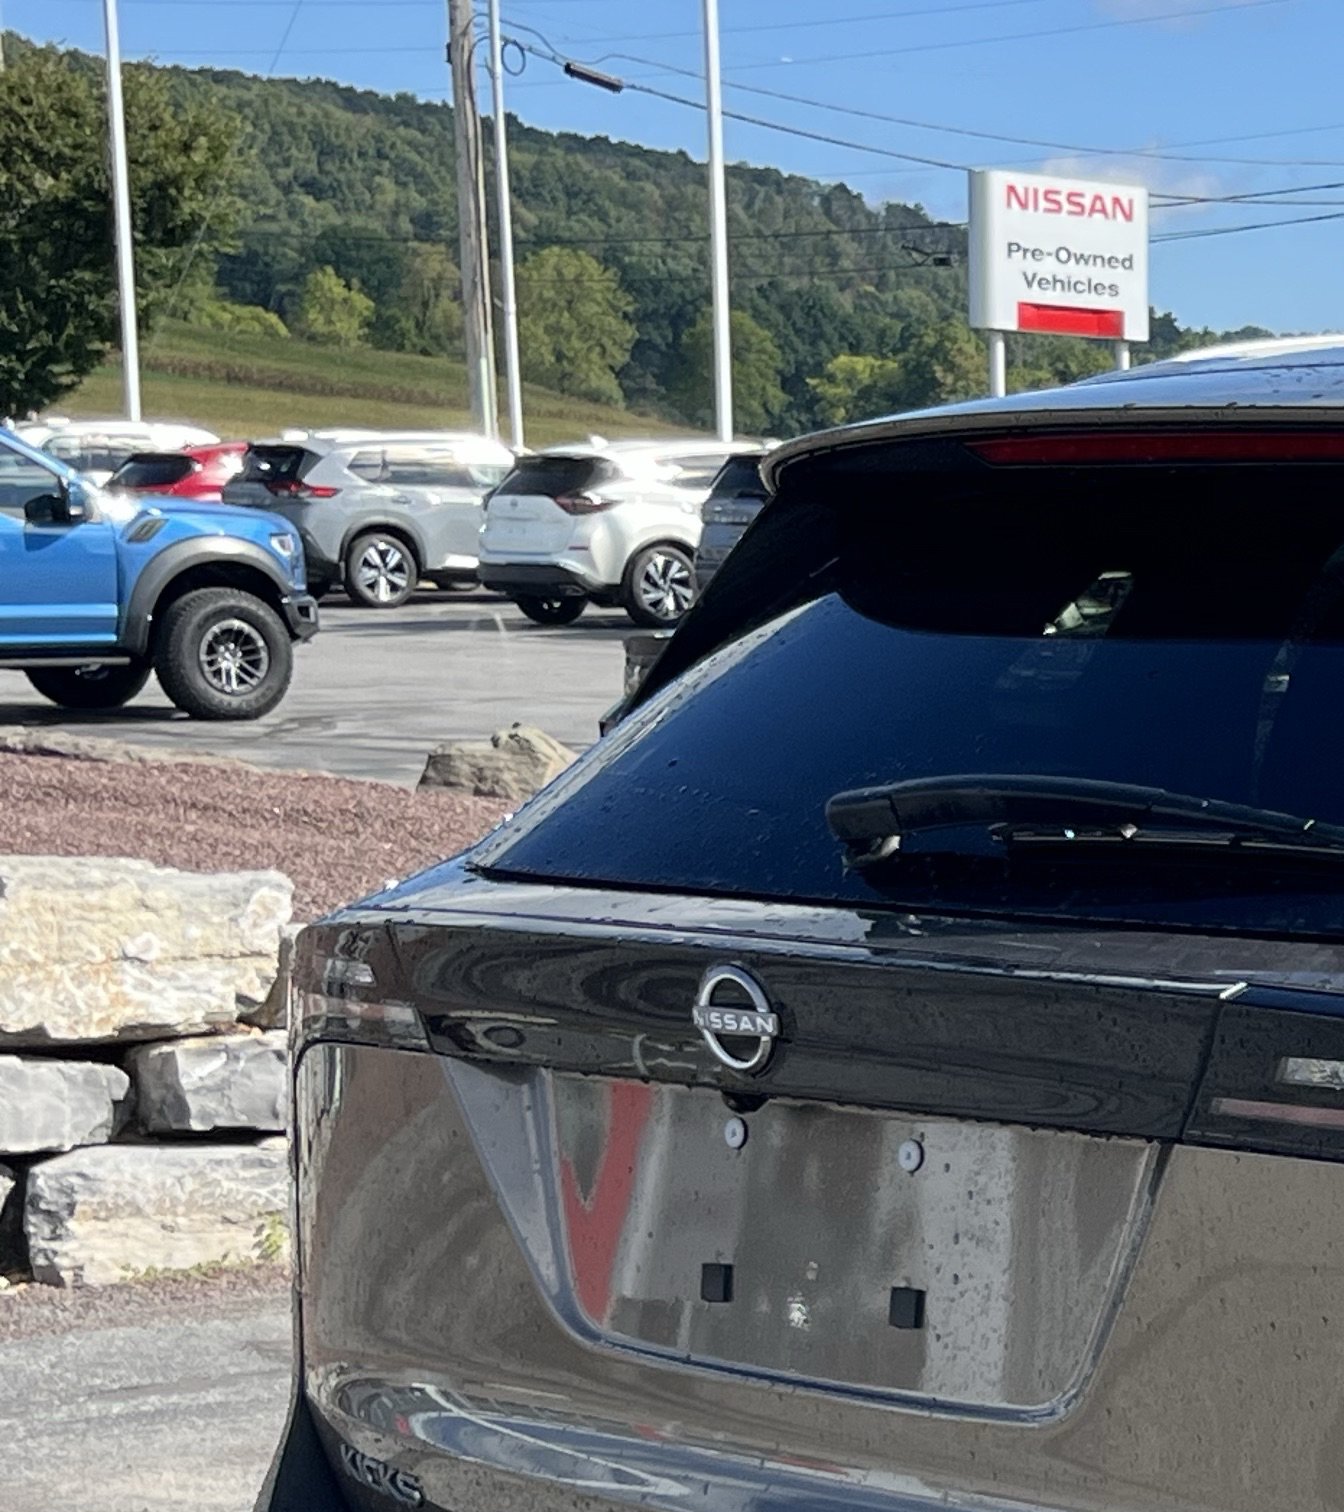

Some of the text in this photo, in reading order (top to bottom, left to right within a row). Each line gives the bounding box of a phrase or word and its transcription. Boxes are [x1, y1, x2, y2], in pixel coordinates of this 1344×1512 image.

[1006, 184, 1134, 222] NISSAN
[1007, 242, 1133, 270] Pre-Owned
[1022, 271, 1120, 297] Vehicles
[693, 1007, 774, 1033] NISSAN
